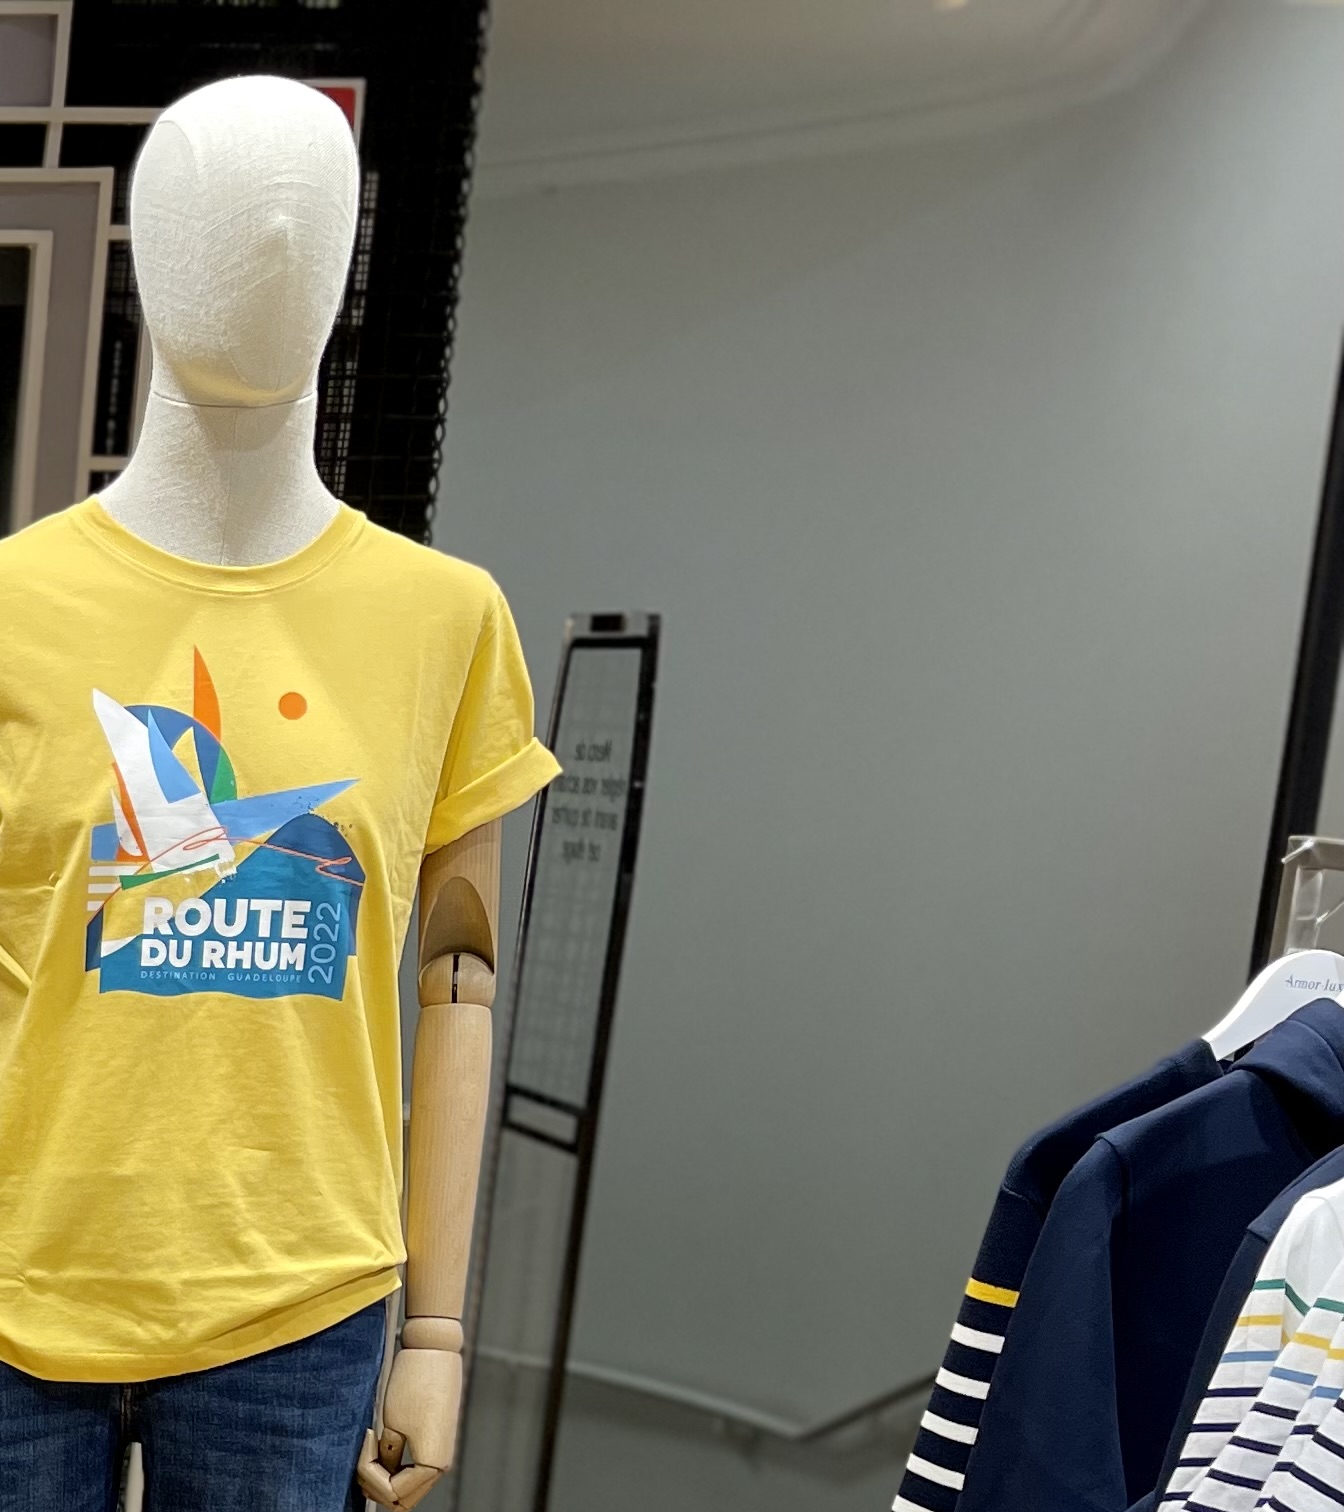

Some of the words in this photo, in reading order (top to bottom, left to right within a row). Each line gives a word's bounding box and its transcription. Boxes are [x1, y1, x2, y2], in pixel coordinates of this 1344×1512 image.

[143, 896, 311, 939] ROUTE
[140, 939, 194, 968] DU
[202, 939, 306, 971] RHUM
[307, 902, 341, 984] 2022
[140, 970, 216, 981] DESTINATION
[227, 972, 302, 984] GUADELOUPE
